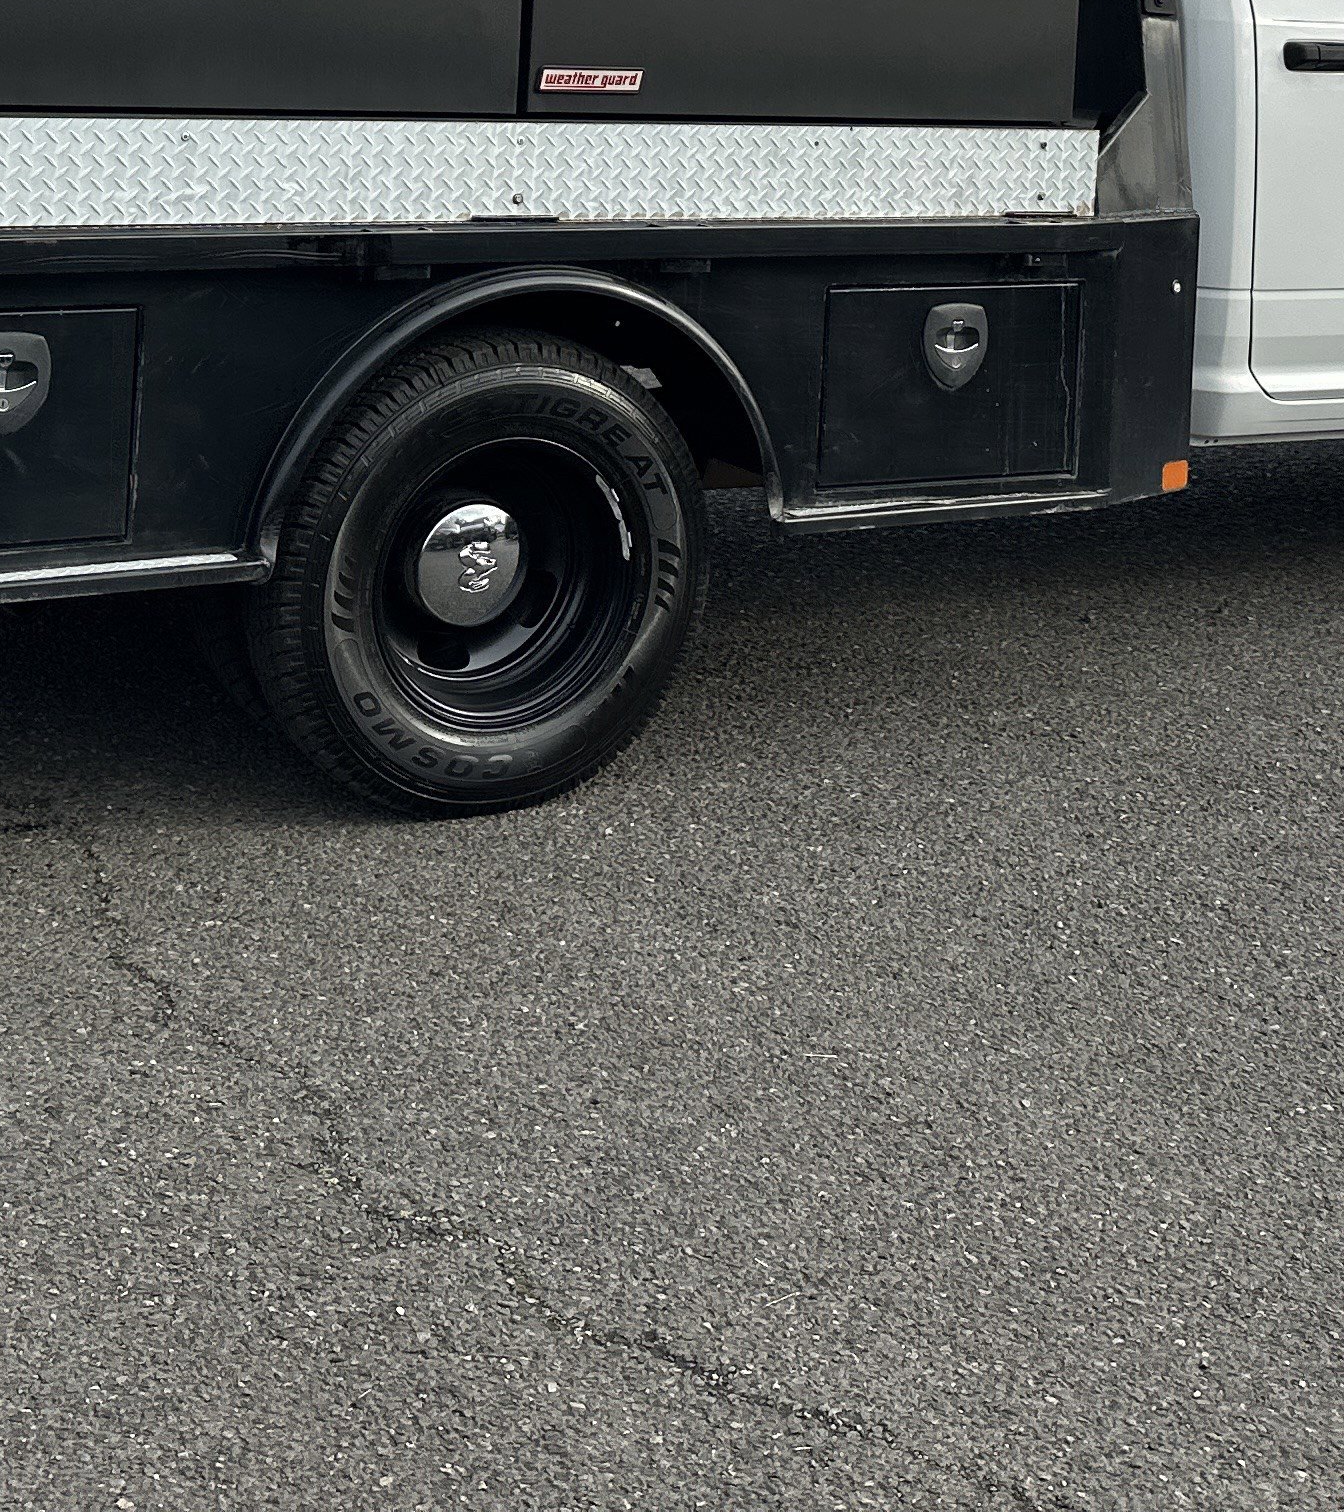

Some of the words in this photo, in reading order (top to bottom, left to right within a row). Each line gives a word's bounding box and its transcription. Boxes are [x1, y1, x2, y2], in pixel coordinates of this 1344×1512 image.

[544, 71, 599, 85] weather
[600, 72, 638, 88] guard
[516, 392, 632, 443] TIGRE
[622, 453, 669, 496] AT
[353, 691, 514, 778] COSMO
